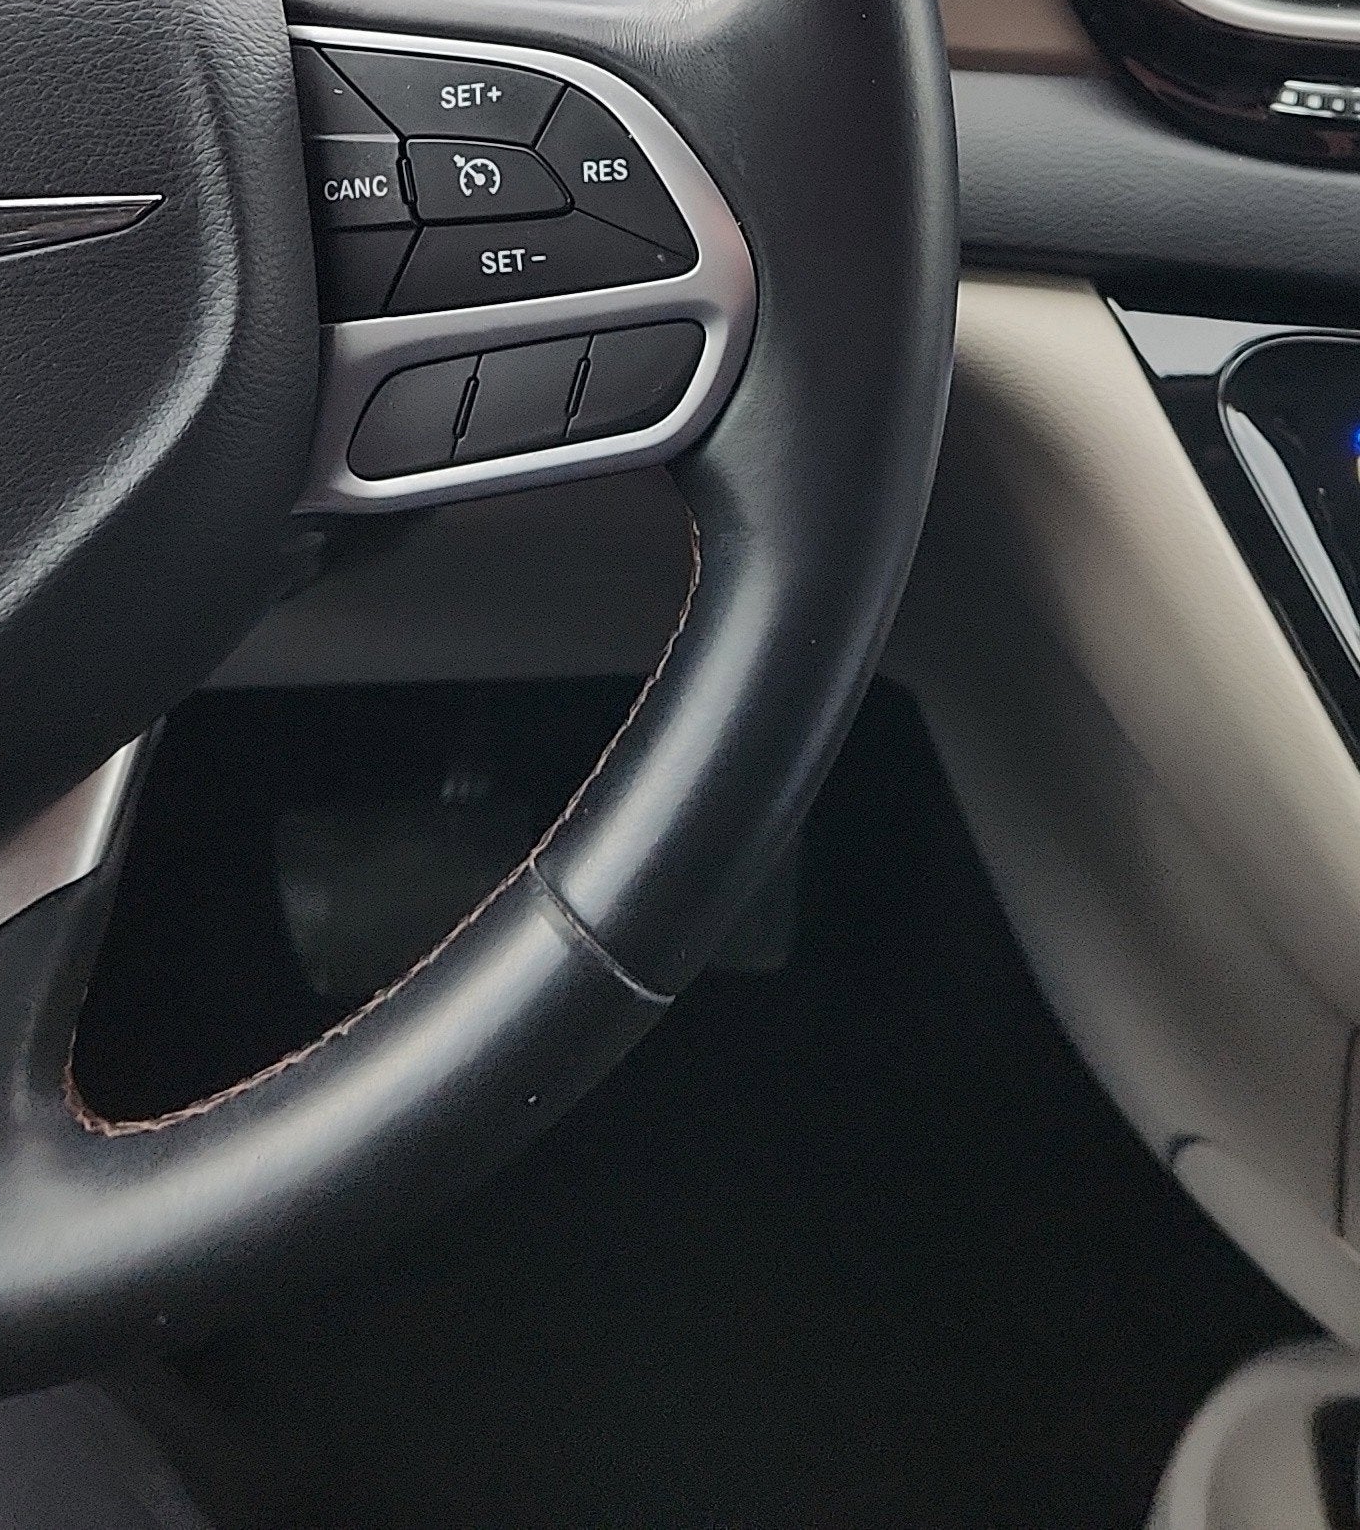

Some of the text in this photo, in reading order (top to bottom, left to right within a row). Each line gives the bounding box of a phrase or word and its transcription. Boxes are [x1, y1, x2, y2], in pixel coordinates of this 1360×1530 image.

[440, 83, 502, 109] SET+
[582, 159, 628, 182] RES
[324, 174, 389, 200] CANC
